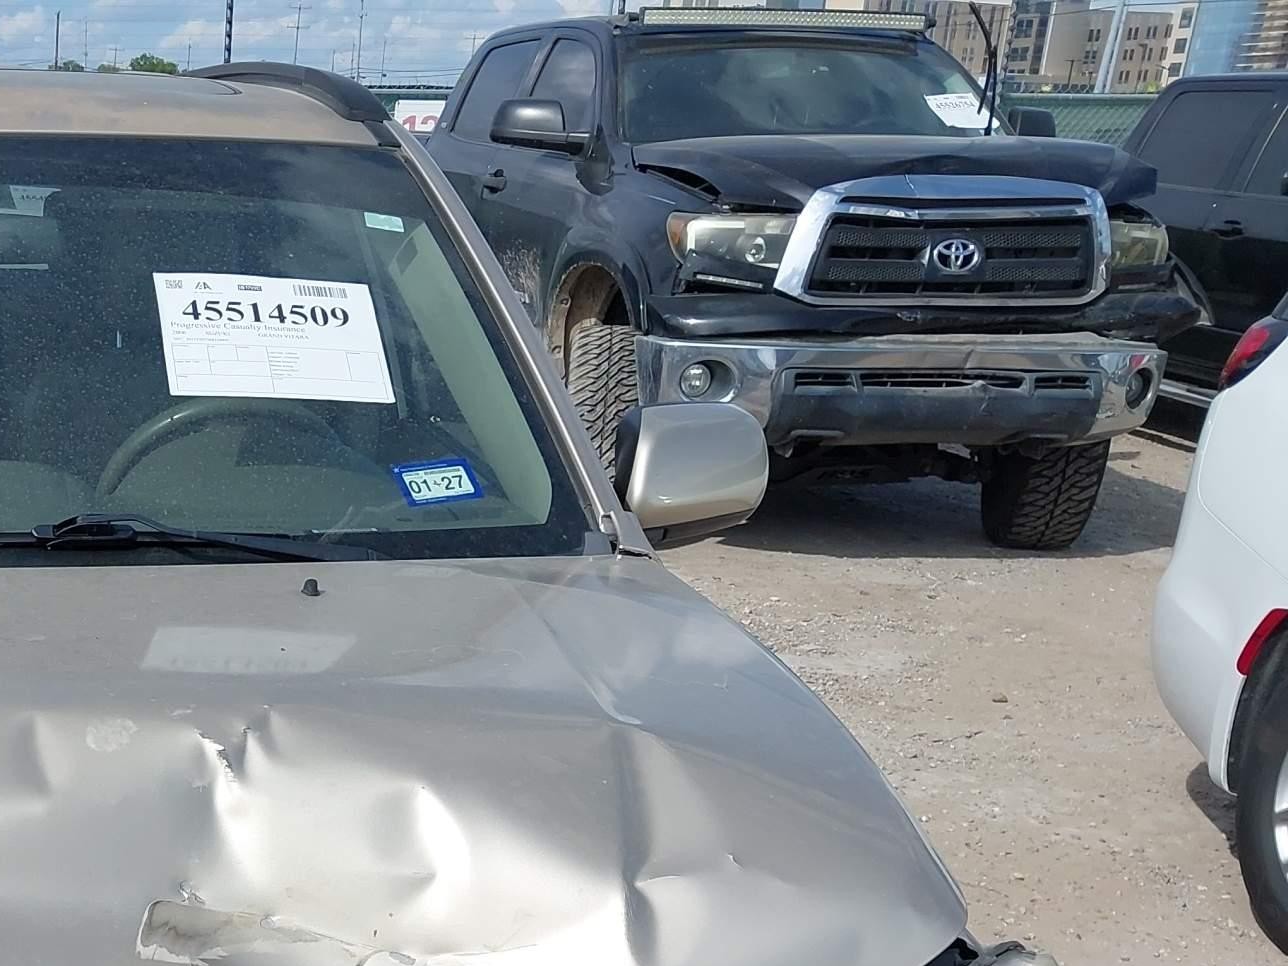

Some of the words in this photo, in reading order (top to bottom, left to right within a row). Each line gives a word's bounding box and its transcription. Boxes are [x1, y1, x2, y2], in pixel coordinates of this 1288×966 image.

[182, 299, 350, 329] 45514509
[170, 321, 222, 331] Progressive
[223, 322, 261, 333] Casualty
[264, 324, 306, 333] Insurance
